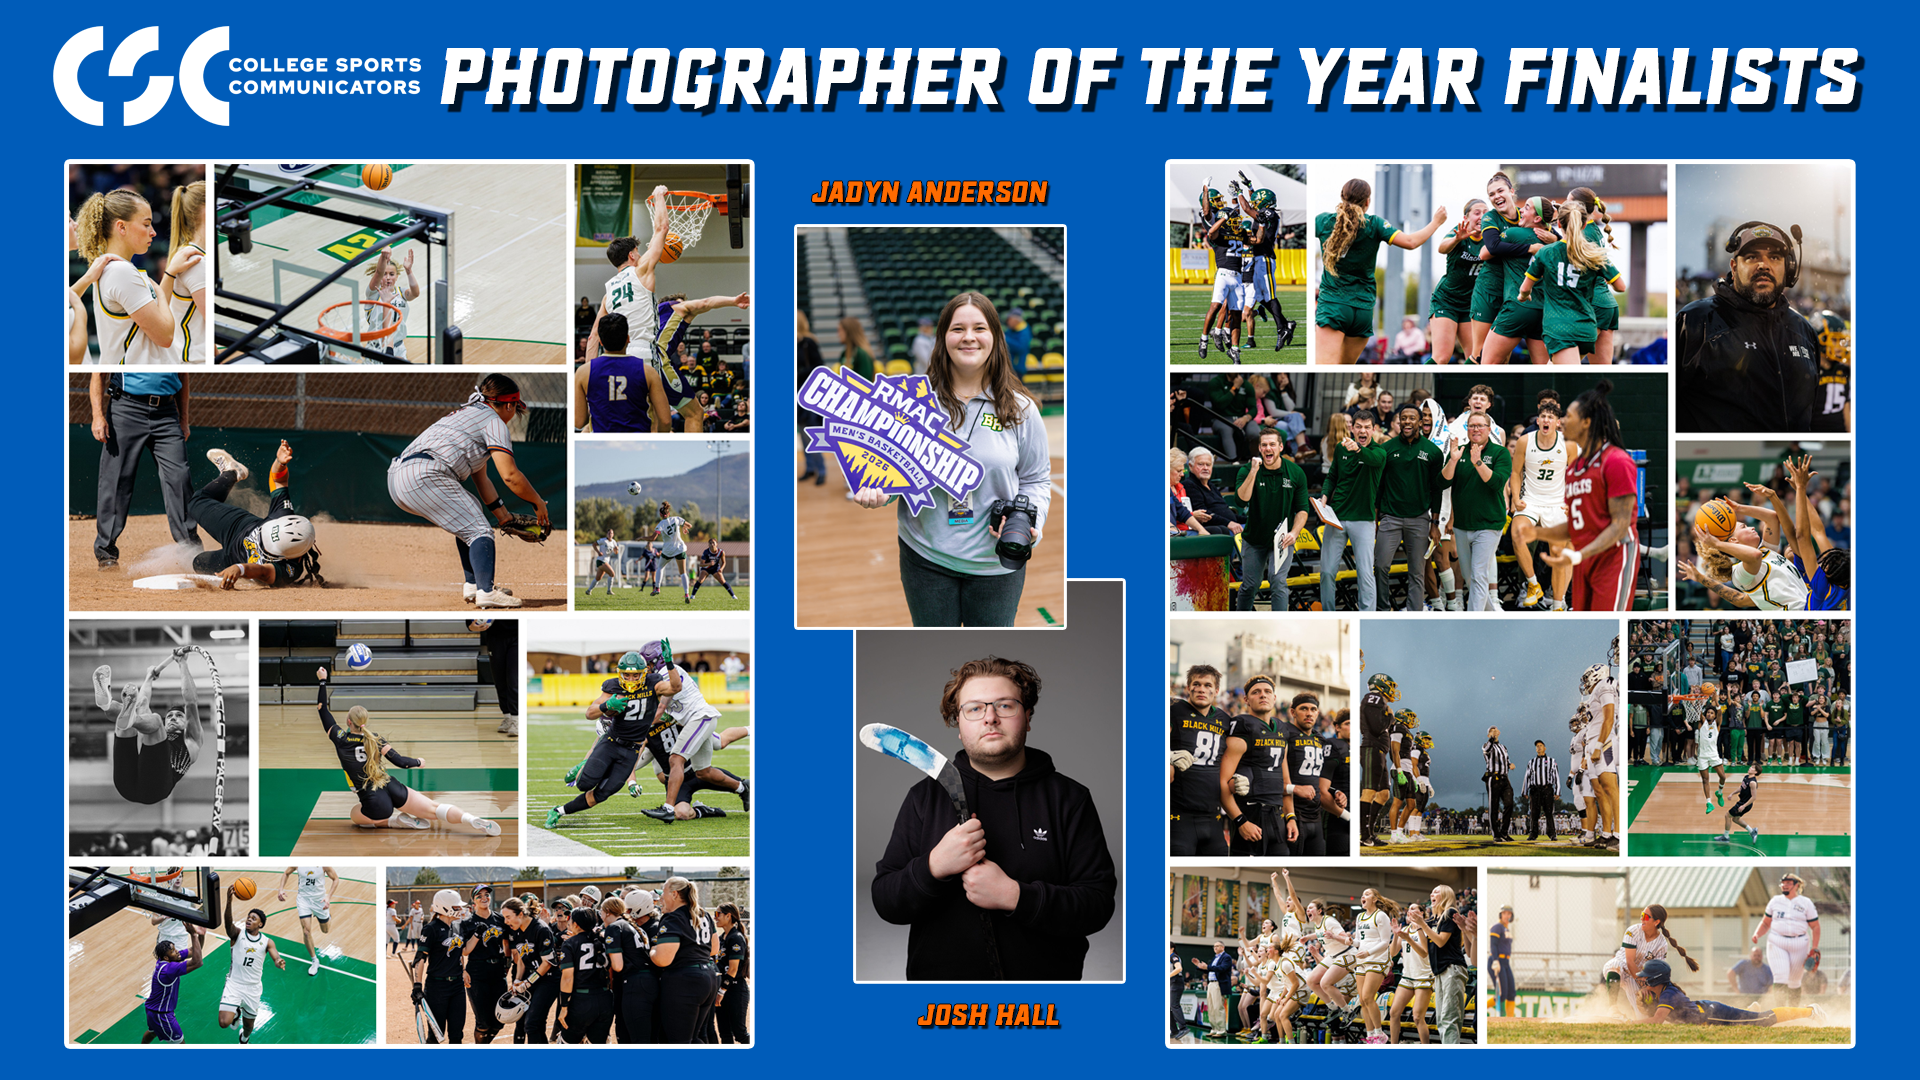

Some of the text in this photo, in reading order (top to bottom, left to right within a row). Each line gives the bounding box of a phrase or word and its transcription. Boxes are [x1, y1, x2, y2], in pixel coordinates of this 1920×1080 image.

[1256, 190, 1267, 199] 12
[1226, 240, 1244, 257] 22
[1557, 262, 1582, 288] 15
[612, 282, 635, 310] 24
[607, 375, 628, 401] 12
[1822, 382, 1847, 415] 15
[871, 379, 945, 437] RMAC
[803, 371, 980, 496] CHAMPIONSHIP
[832, 425, 924, 486] MEN'S BASKETBALL
[861, 450, 890, 473] 2026
[1537, 468, 1555, 481] 32
[1570, 497, 1585, 531] 5
[1705, 502, 1727, 525] Wilson
[666, 523, 678, 535] 27
[623, 698, 648, 721] 21
[1367, 694, 1381, 705] 27
[648, 723, 668, 737] BLACK
[1182, 719, 1208, 731] BLACK
[1229, 720, 1238, 736] 7
[355, 745, 368, 763] 6
[1192, 730, 1221, 766] 81
[1254, 738, 1275, 747] BLACK
[1295, 739, 1314, 747] BLACK
[1267, 747, 1282, 772] 7
[1298, 745, 1325, 777] 89
[305, 878, 316, 886] 24
[1231, 884, 1240, 936] TRIATHLON
[1360, 930, 1366, 940] 5
[243, 956, 255, 967] 12
